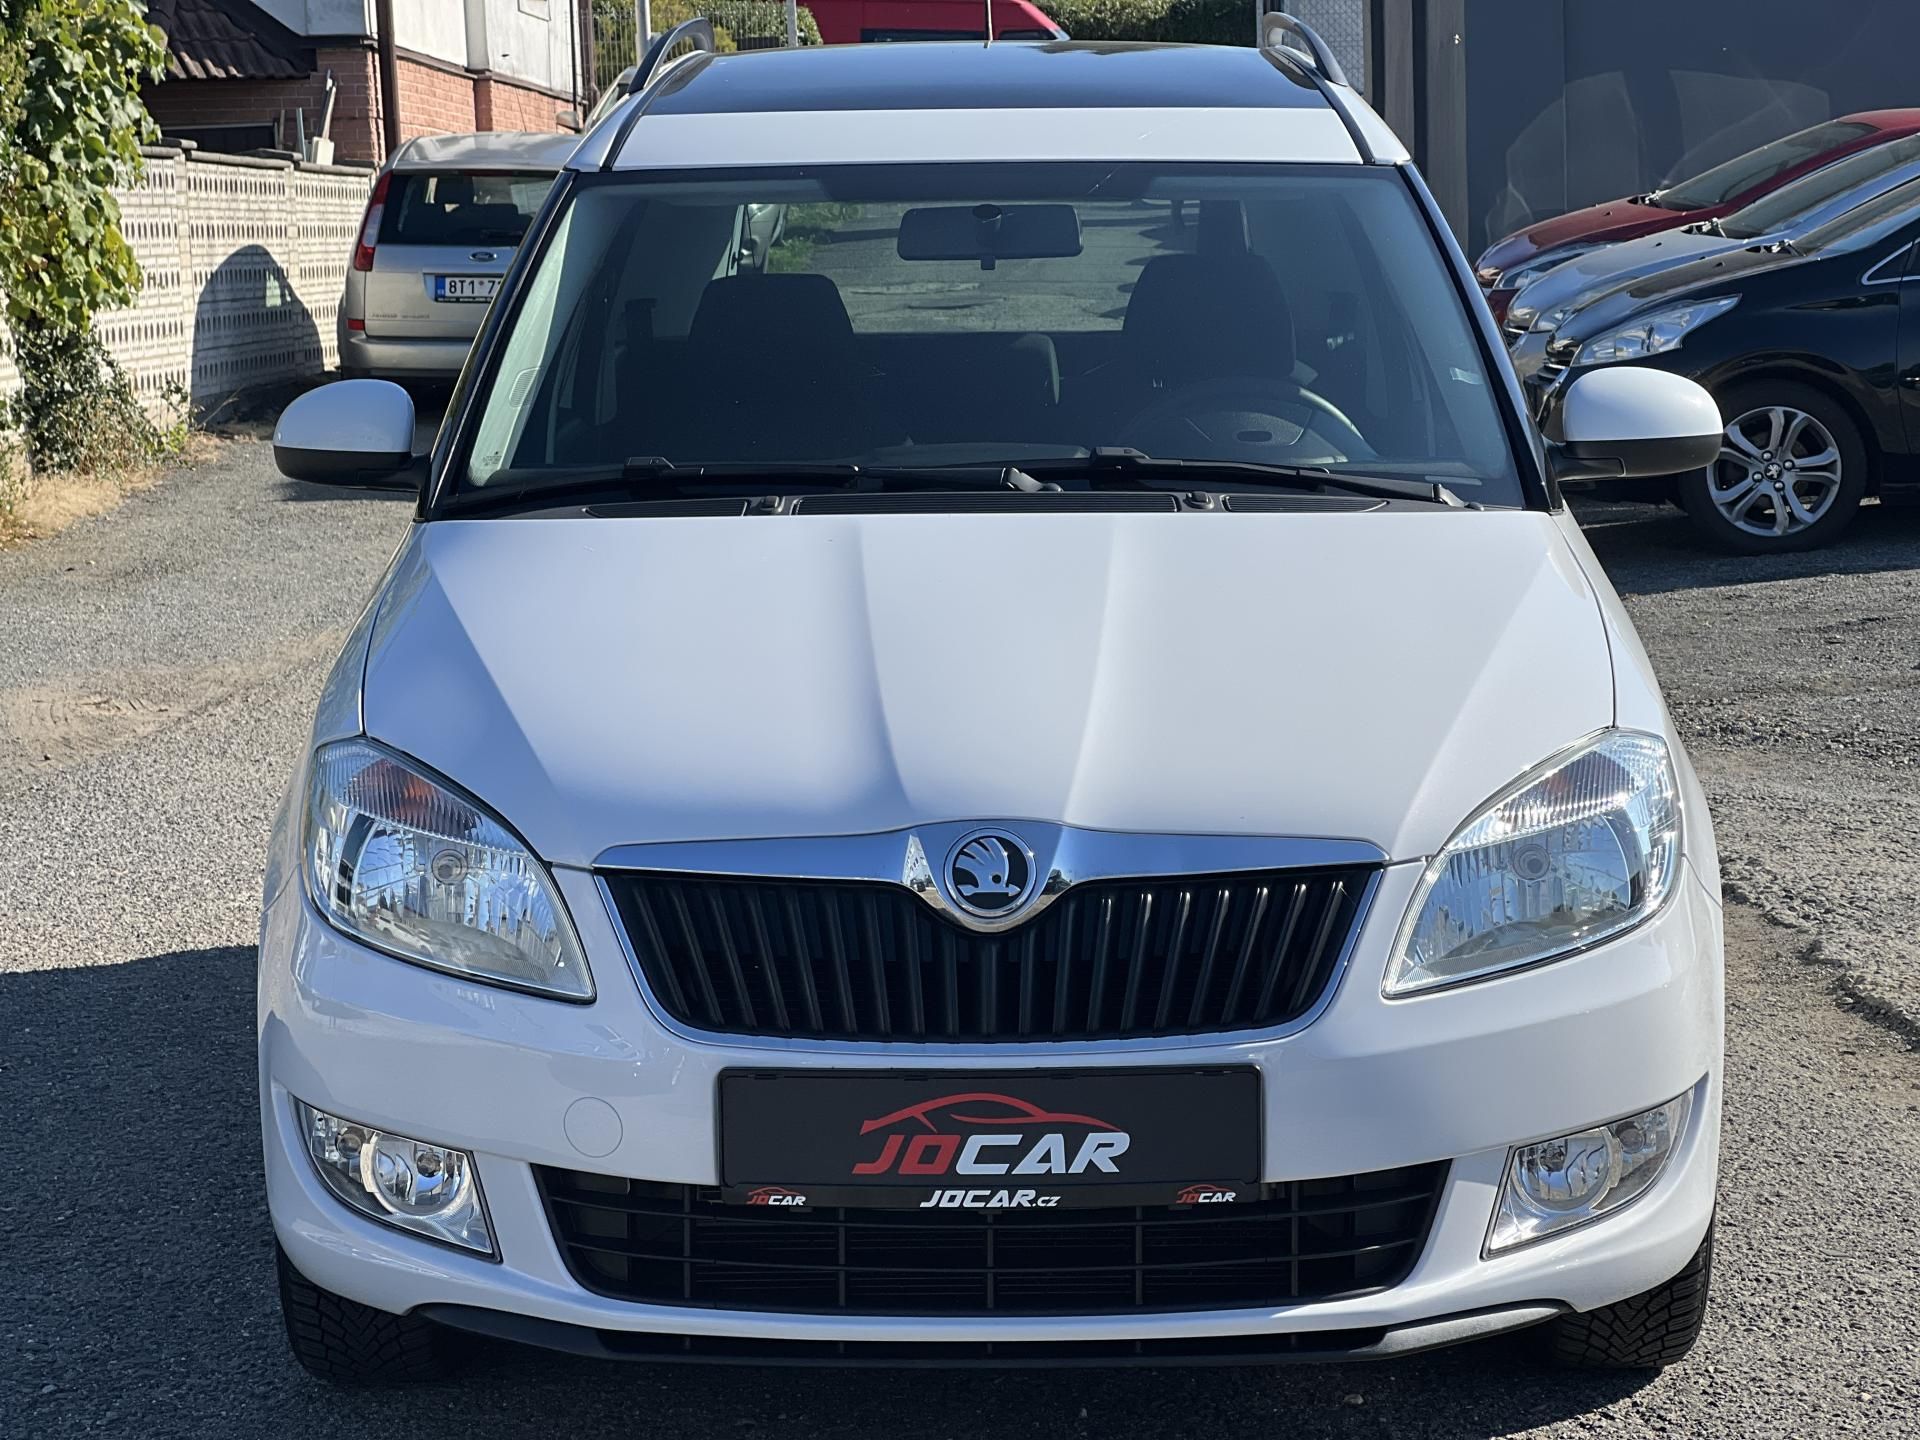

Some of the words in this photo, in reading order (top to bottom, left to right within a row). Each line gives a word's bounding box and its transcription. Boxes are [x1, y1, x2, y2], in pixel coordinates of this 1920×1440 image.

[449, 280, 475, 294] 8T1
[487, 280, 501, 294] 7
[851, 1132, 1130, 1175] JOCAR
[746, 1195, 806, 1205] JOCAR
[1175, 1192, 1236, 1203] JOCAR
